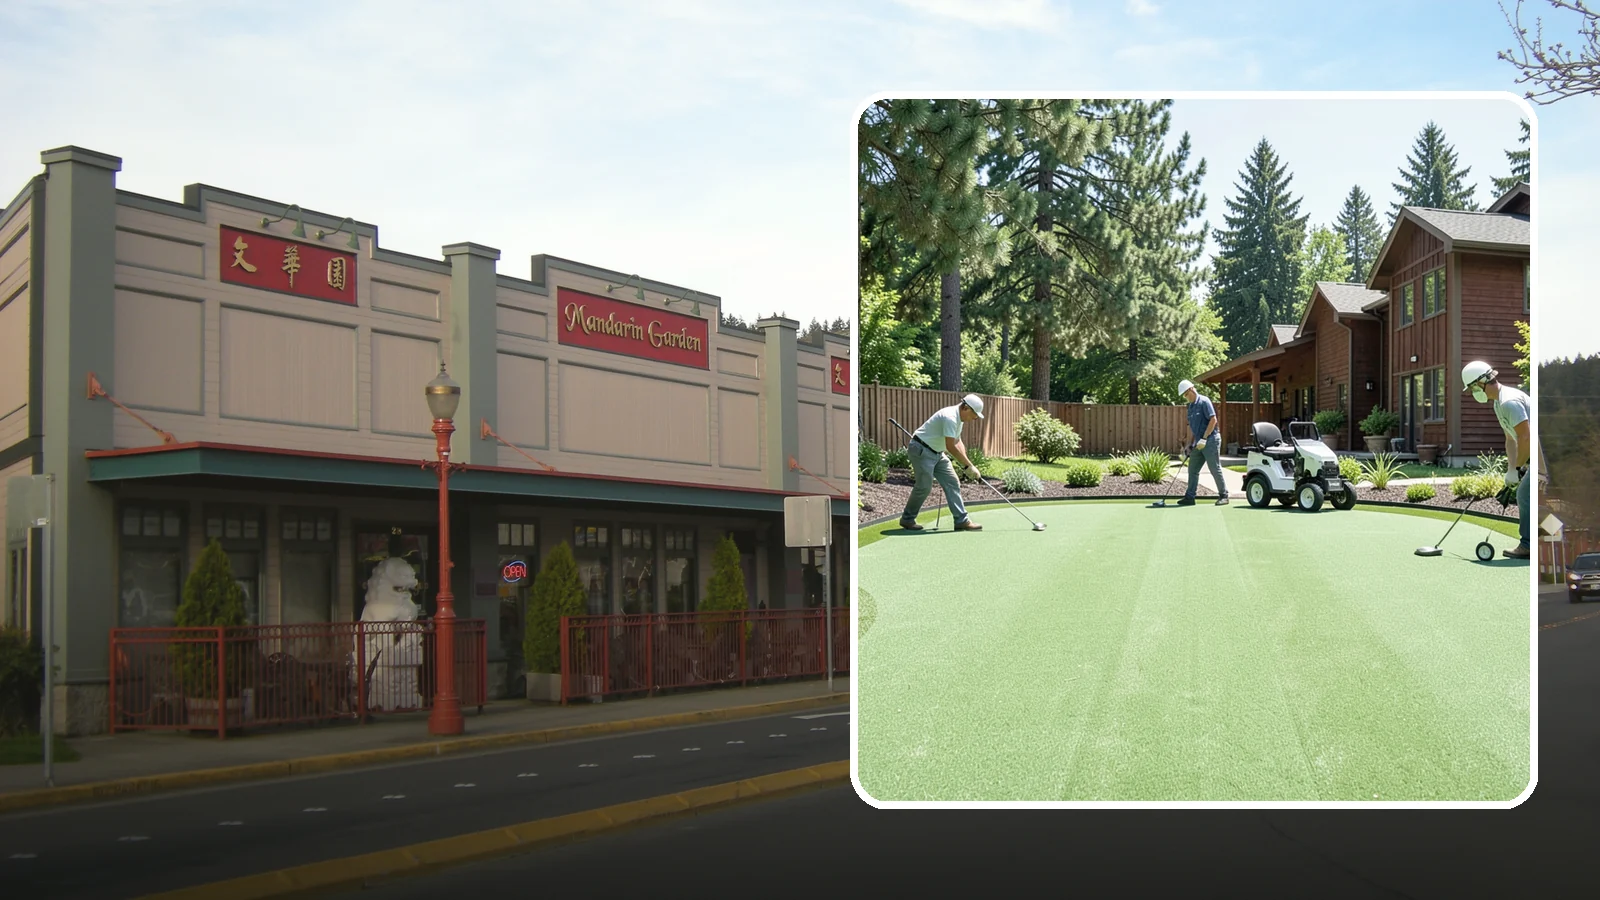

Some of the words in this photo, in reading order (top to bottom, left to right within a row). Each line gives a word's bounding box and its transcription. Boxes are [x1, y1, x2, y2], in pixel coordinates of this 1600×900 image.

[231, 235, 346, 290] 文華園
[564, 302, 644, 340] Mandarin
[648, 320, 702, 352] Garden
[503, 565, 527, 578] OPEN
